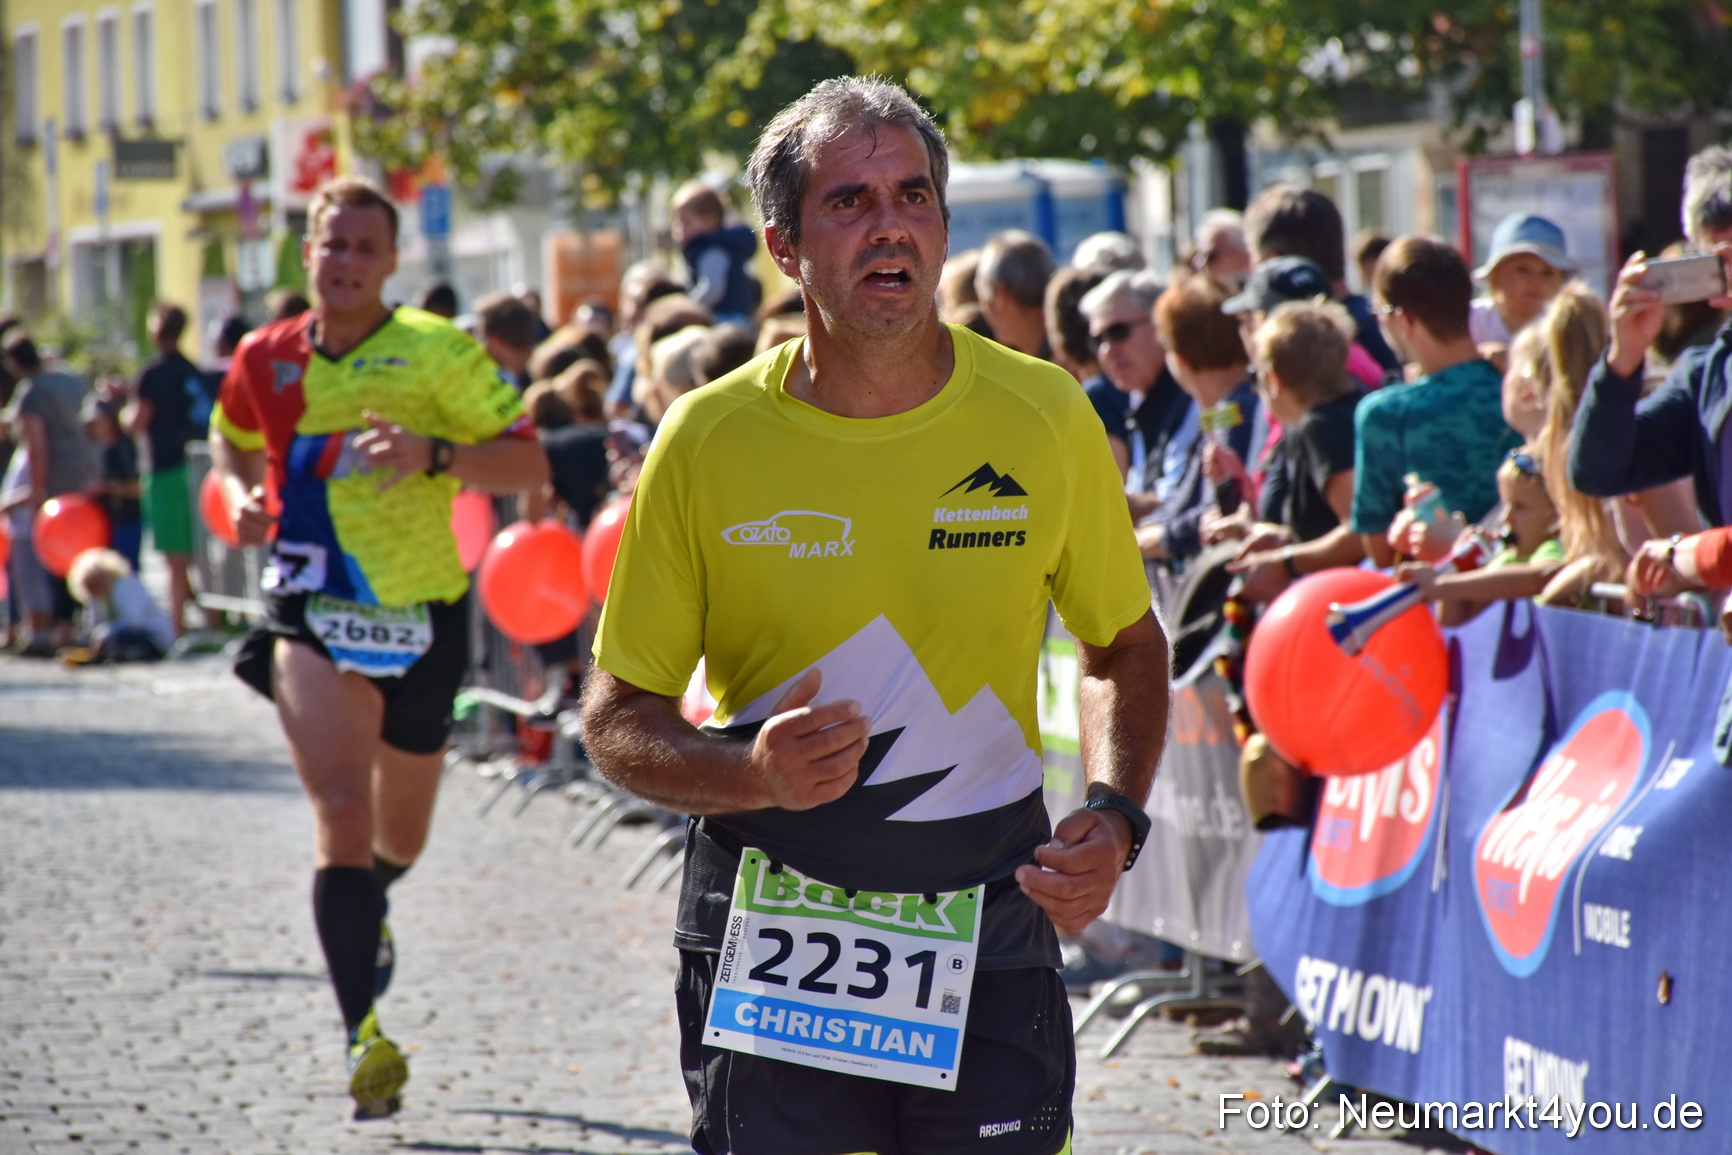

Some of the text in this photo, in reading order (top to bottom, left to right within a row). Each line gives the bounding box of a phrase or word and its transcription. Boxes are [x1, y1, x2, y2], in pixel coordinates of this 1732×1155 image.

[933, 504, 1029, 523] Kettenbach
[789, 540, 856, 558] MARX
[928, 529, 1027, 550] Runners
[322, 619, 415, 646] 2682
[748, 928, 937, 1009] 2231
[734, 1002, 936, 1059] CHRISTIAN
[979, 1120, 1021, 1138] ARSUXEO
